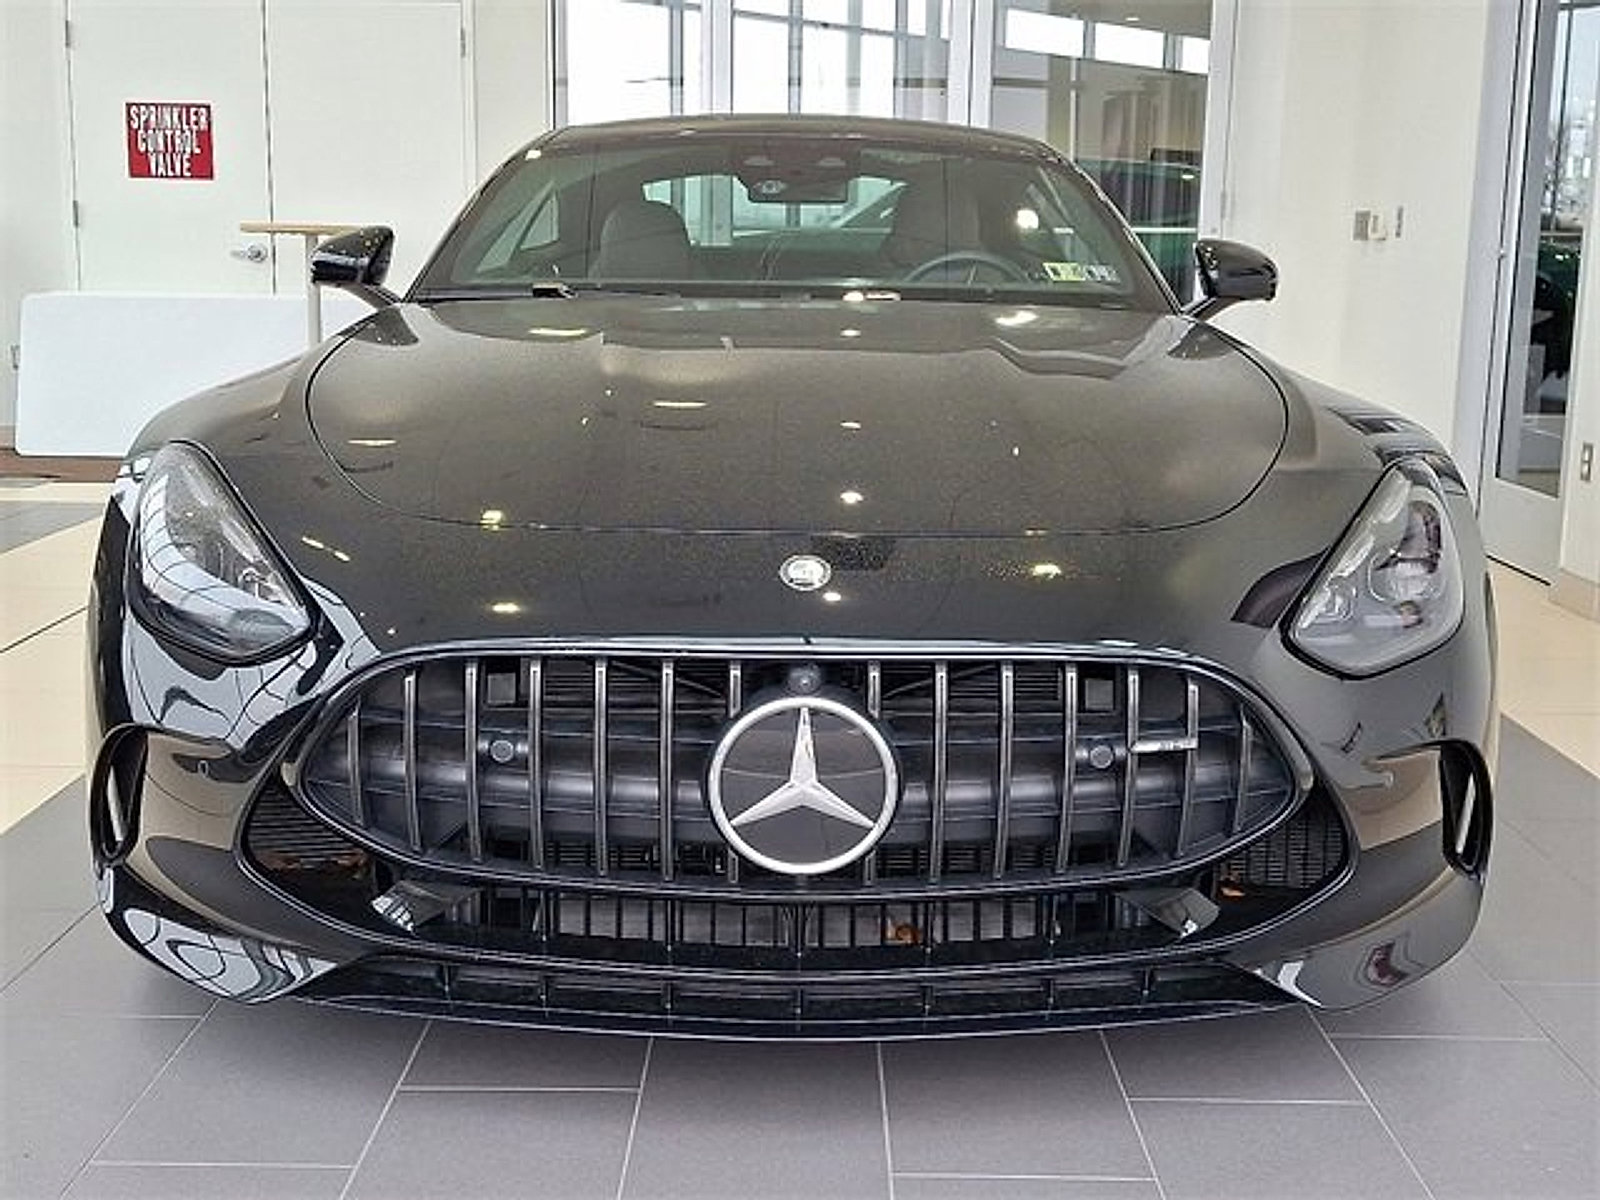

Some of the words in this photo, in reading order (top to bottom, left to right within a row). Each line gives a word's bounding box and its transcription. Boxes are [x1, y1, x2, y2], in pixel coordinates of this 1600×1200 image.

[130, 105, 208, 130] SPRINKLER
[138, 130, 201, 154] CONTROL
[149, 153, 191, 176] VALVE
